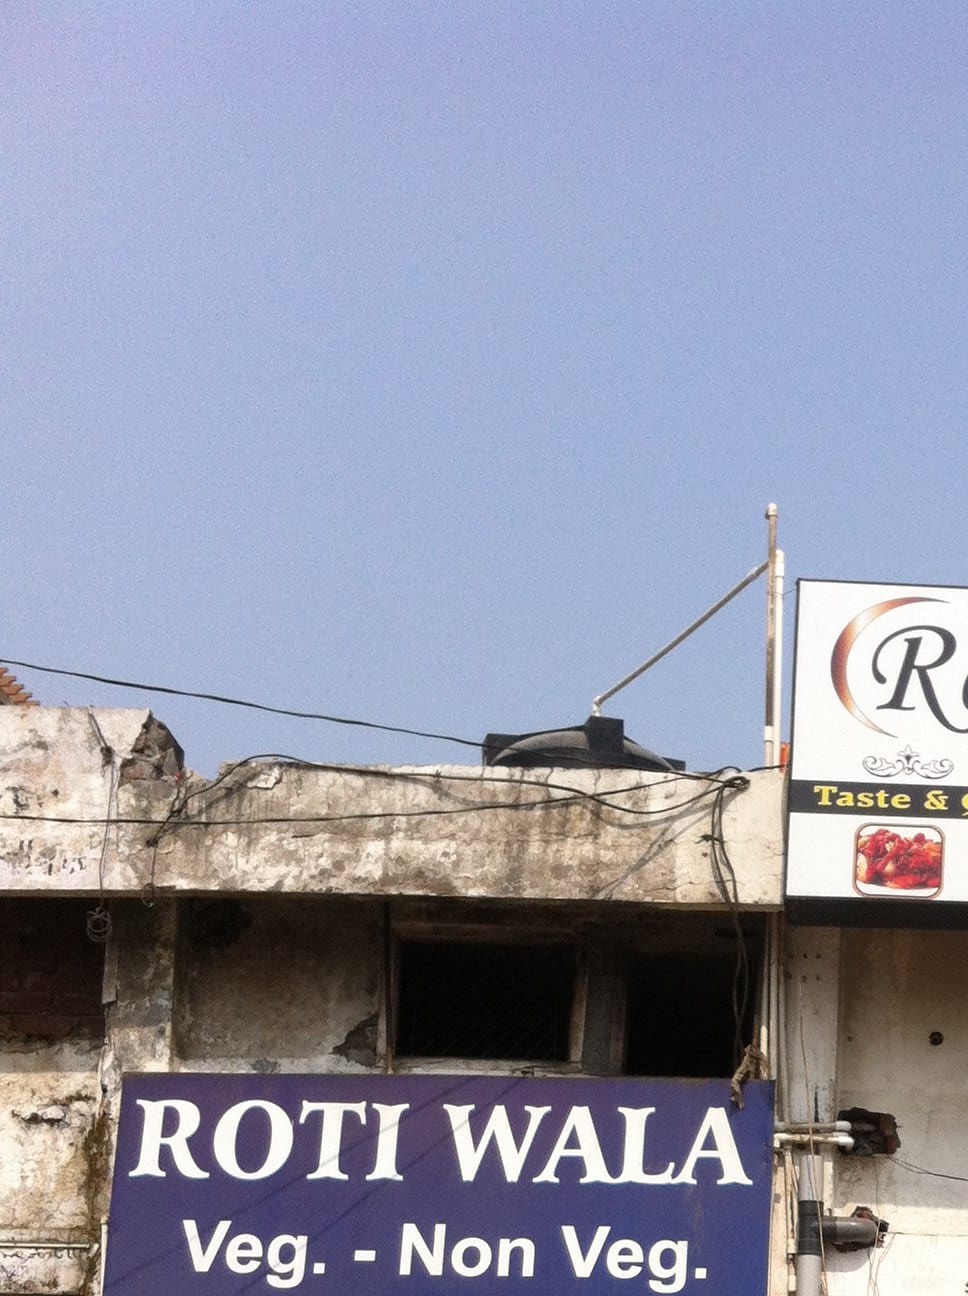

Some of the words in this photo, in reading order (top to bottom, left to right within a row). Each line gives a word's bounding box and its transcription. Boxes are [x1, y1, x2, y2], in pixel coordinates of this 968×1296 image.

[814, 785, 911, 810] Taste
[924, 790, 949, 812] &
[128, 1099, 410, 1181] ROTI
[443, 1103, 753, 1185] WALA
[182, 1219, 326, 1289] Veg.
[353, 1249, 377, 1261] -
[399, 1223, 536, 1277] Non
[561, 1225, 707, 1294] Veg.
